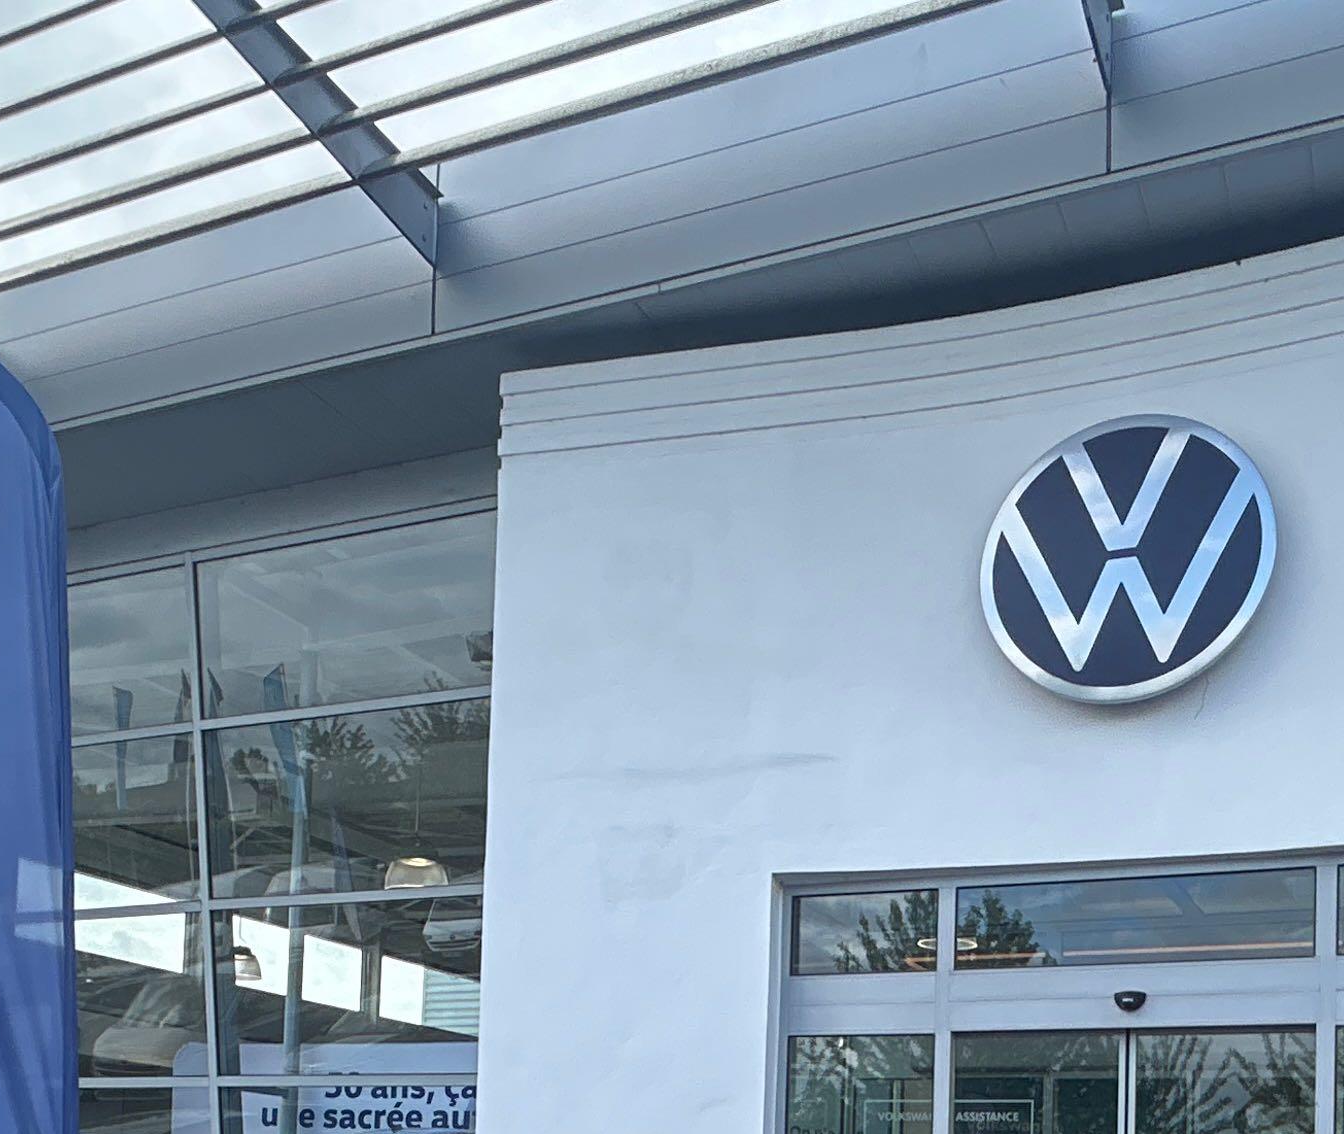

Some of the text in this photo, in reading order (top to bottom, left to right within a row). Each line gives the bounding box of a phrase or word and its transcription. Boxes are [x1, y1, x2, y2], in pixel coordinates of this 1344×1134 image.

[980, 413, 1277, 705] VW
[261, 1101, 476, 1130] ue sacrée au
[877, 1111, 1020, 1122] VOLKSWA ASSISTANCE
